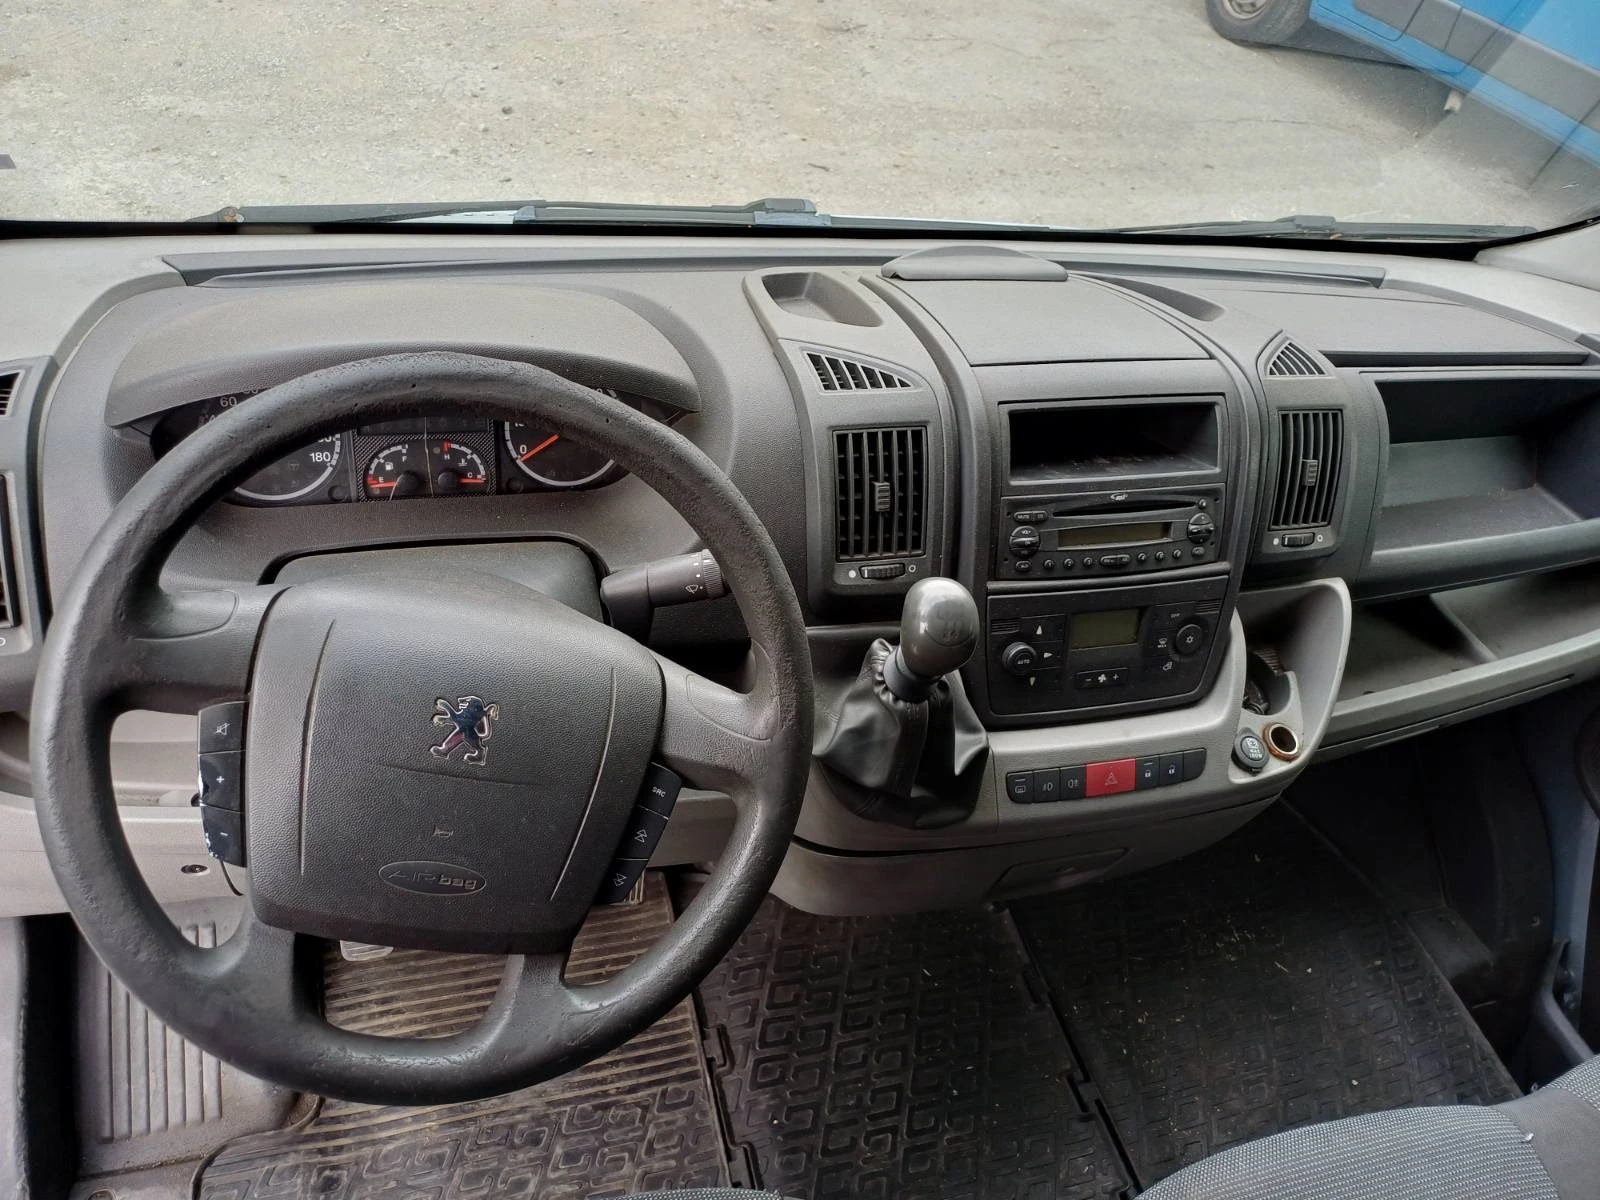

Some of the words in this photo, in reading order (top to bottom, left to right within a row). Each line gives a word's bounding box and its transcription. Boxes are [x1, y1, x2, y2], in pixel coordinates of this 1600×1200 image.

[220, 396, 237, 407] 60
[520, 444, 527, 454] 0
[310, 451, 331, 463] 180
[402, 455, 408, 463] F
[652, 786, 666, 797] SRC
